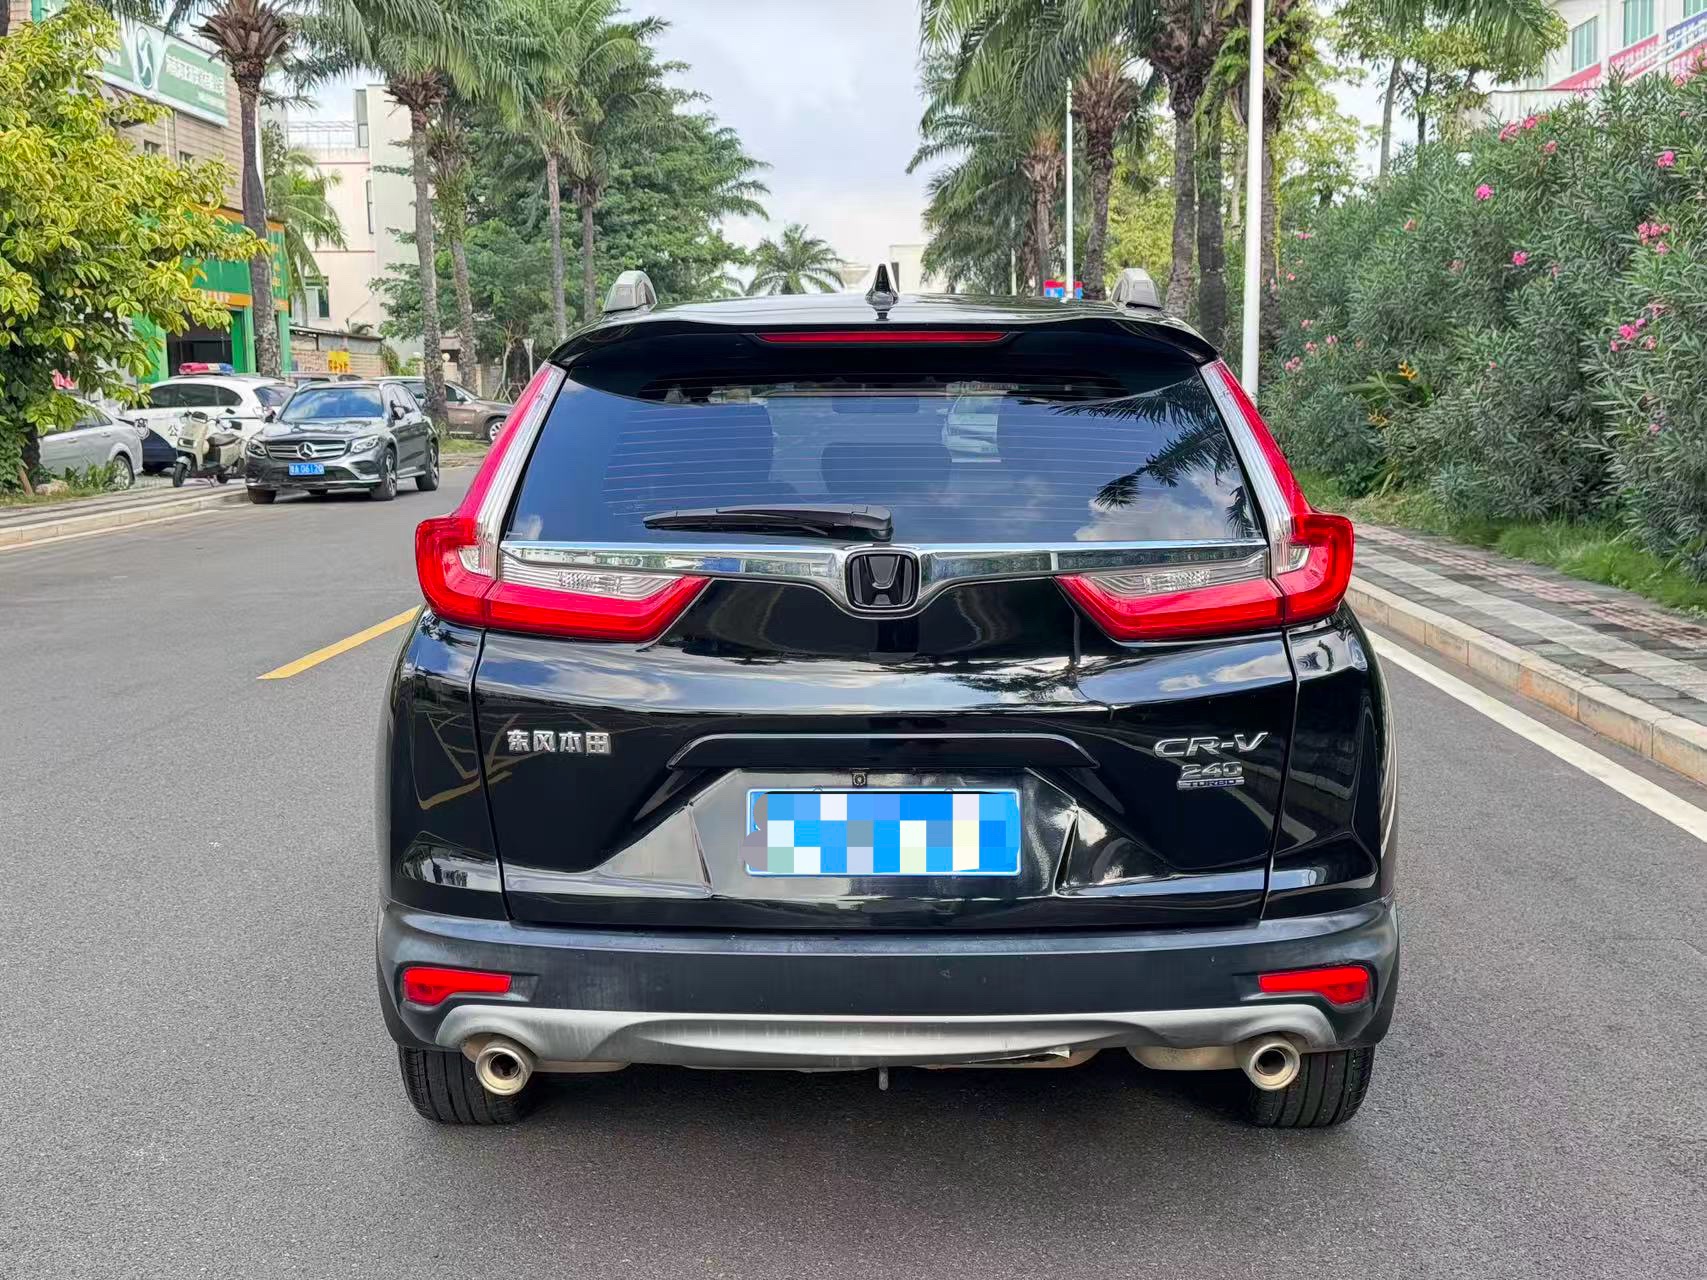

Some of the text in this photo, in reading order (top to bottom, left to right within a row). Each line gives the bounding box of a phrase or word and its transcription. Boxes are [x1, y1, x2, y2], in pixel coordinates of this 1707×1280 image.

[507, 729, 611, 754] 东风本田
[1154, 732, 1268, 757] CR-V
[1181, 761, 1242, 779] 240
